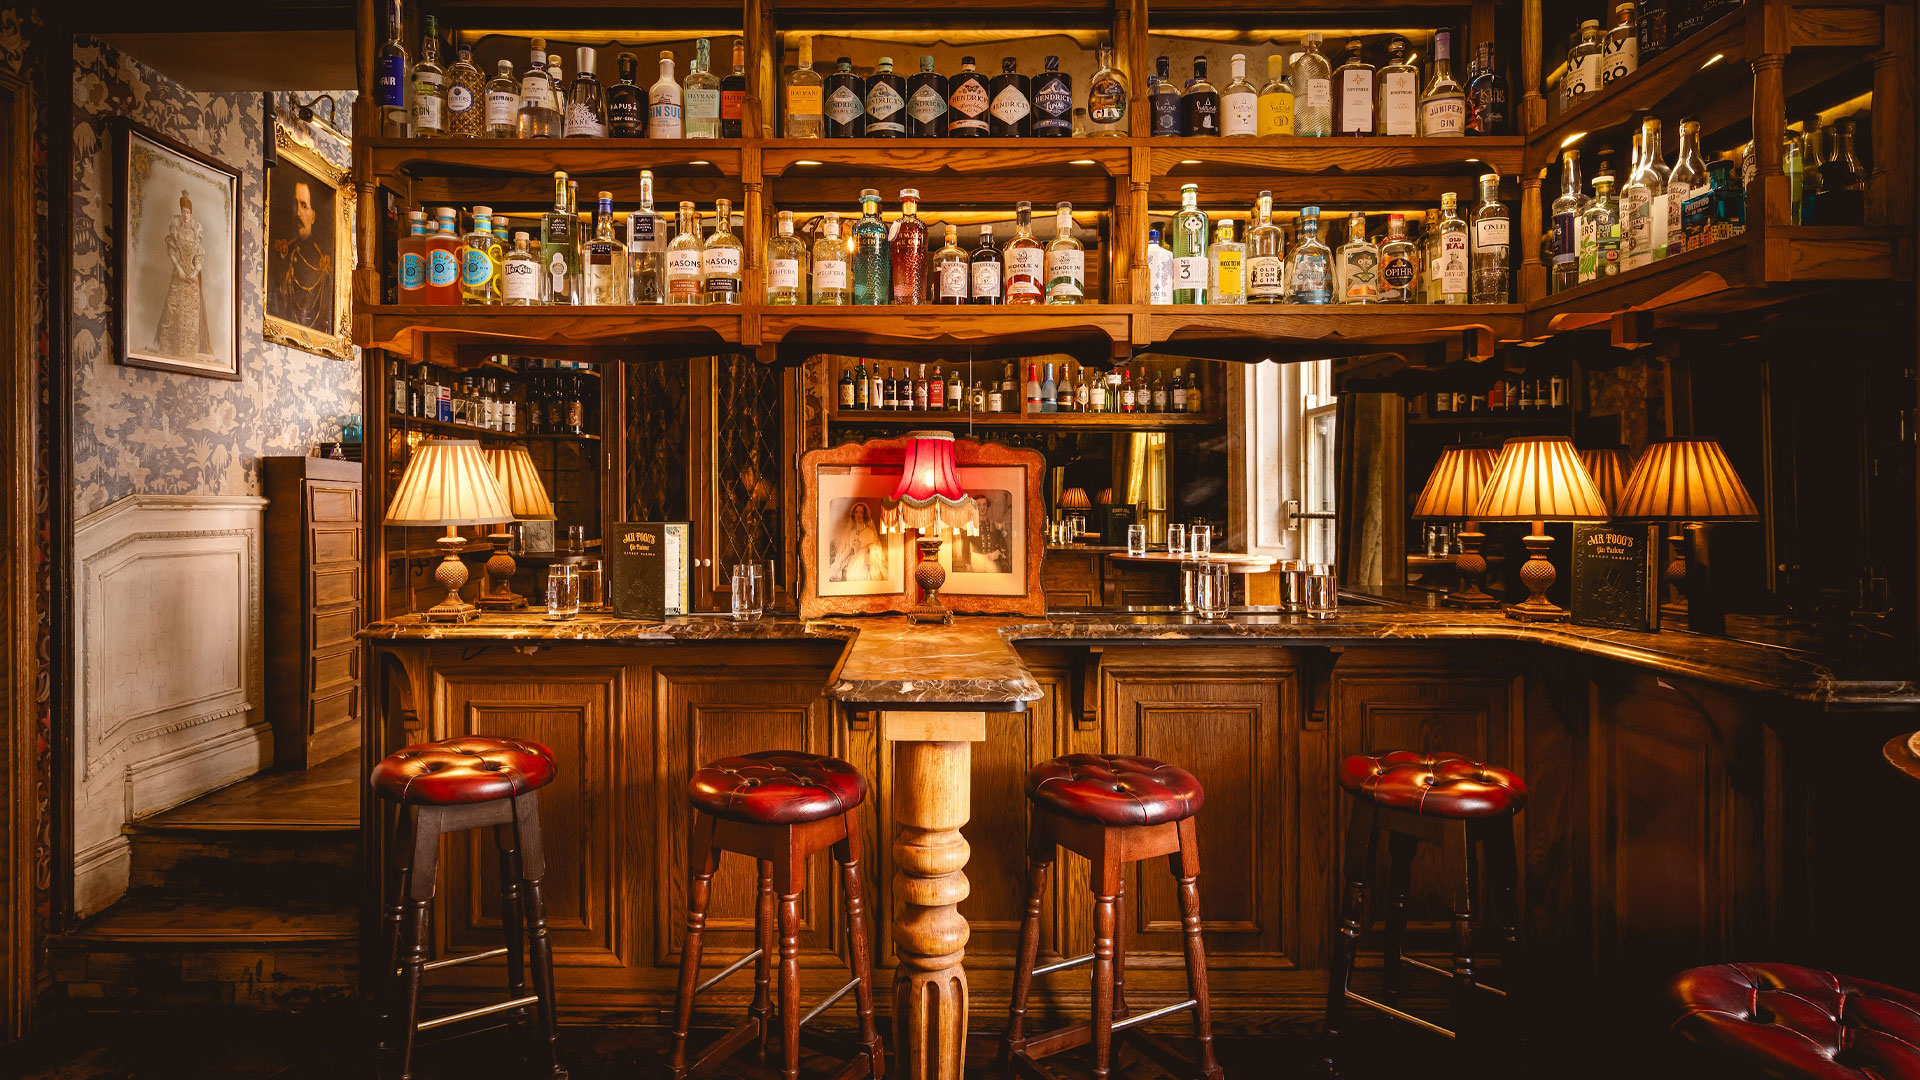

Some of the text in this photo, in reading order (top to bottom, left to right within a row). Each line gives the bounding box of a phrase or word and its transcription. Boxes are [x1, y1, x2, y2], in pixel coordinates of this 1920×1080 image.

[1440, 119, 1456, 128] GIN
[669, 259, 702, 269] MASONS
[705, 258, 738, 267] MASONS
[1180, 264, 1191, 280] 3
[1384, 267, 1413, 277] OPIHR
[1587, 533, 1604, 546] MR
